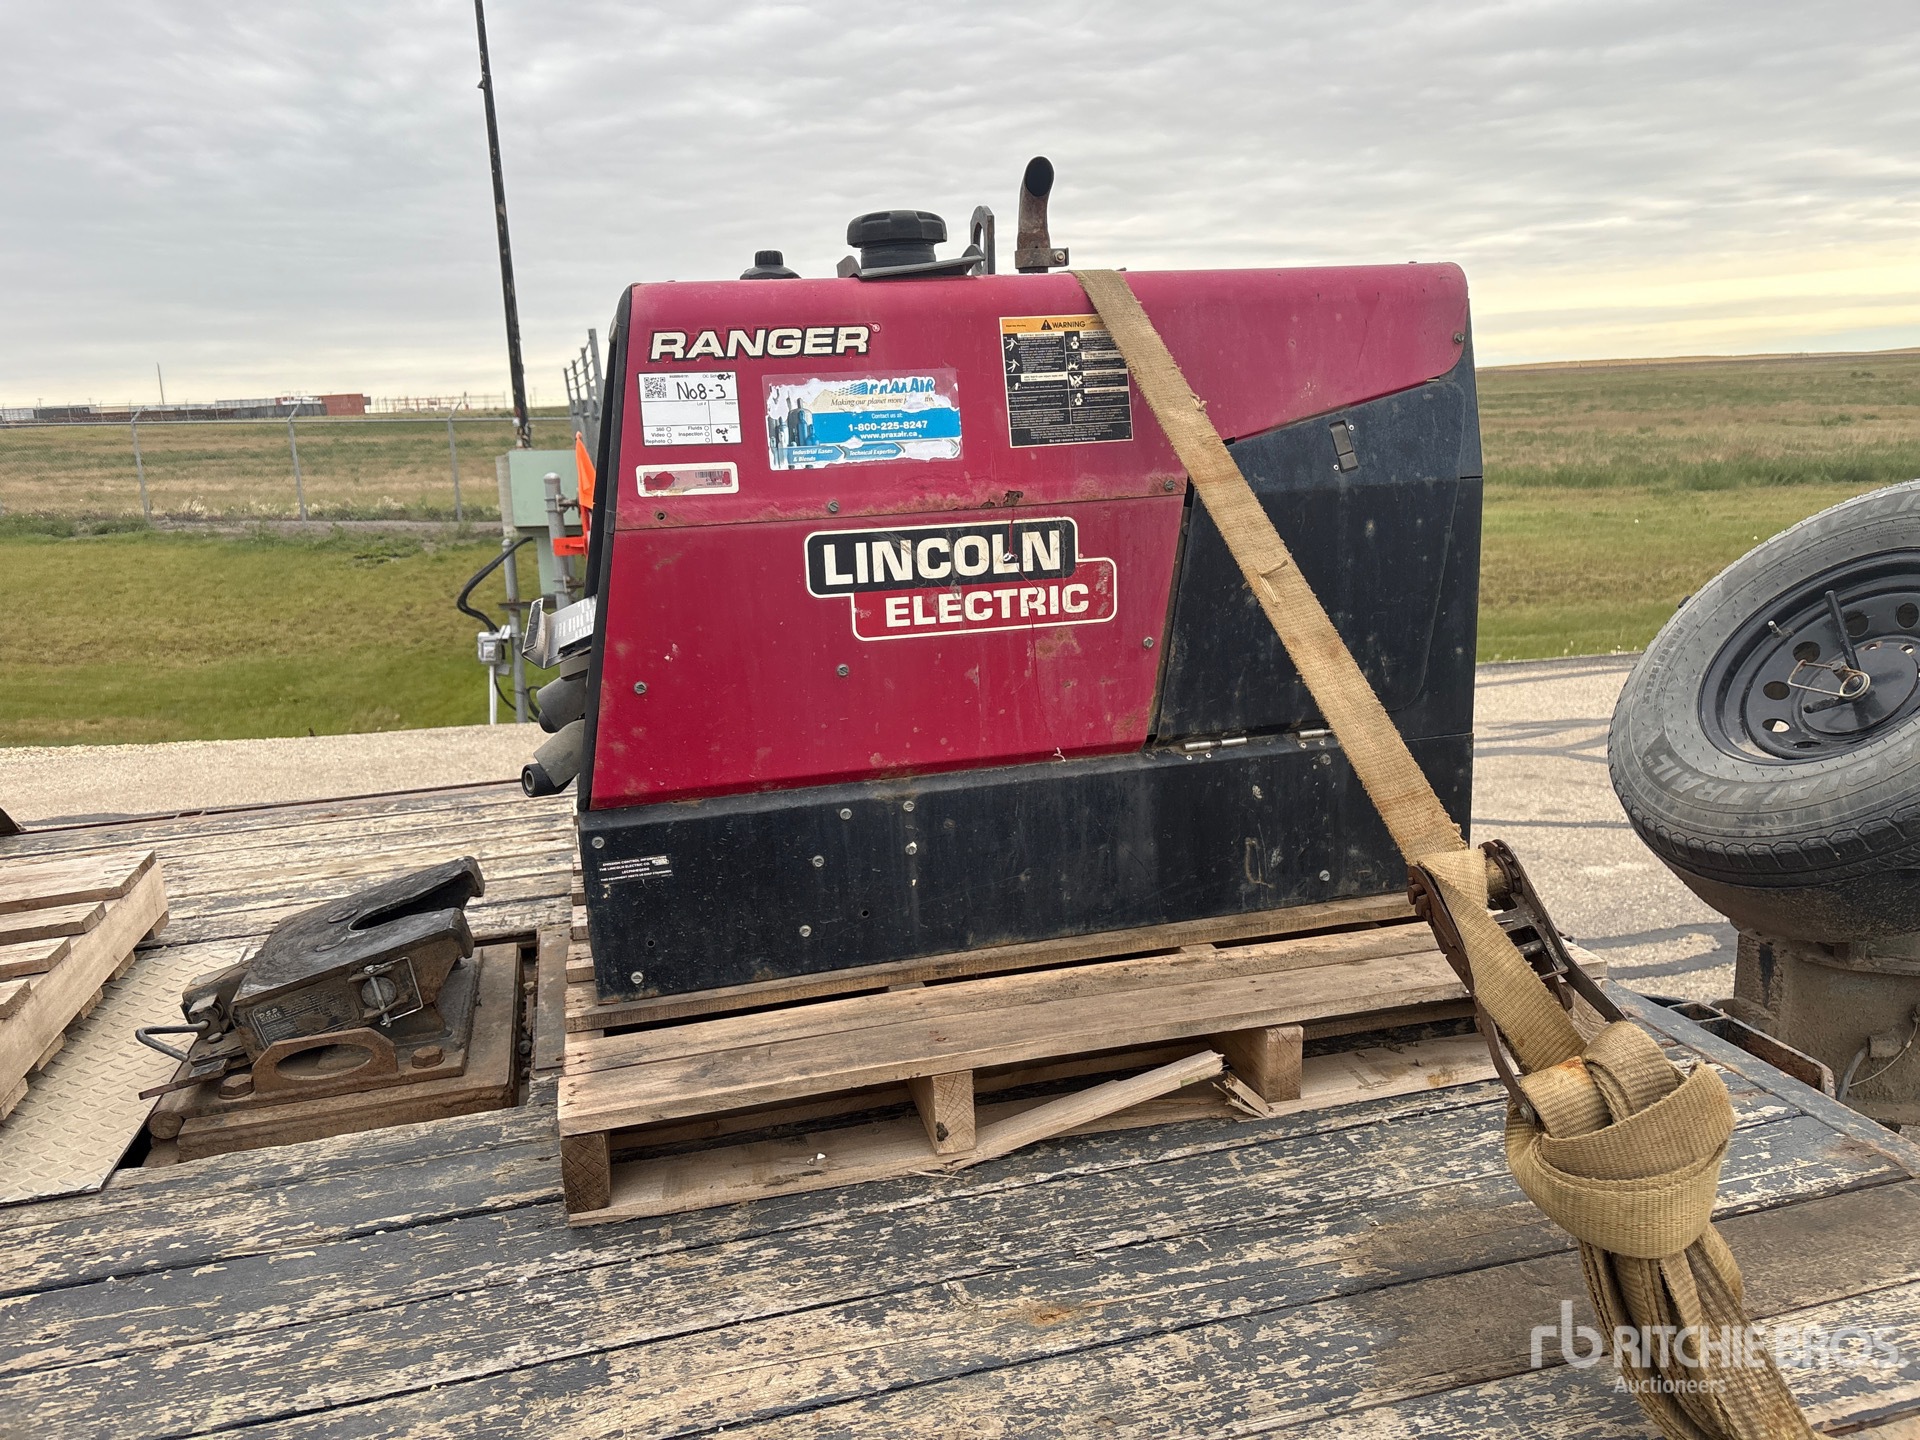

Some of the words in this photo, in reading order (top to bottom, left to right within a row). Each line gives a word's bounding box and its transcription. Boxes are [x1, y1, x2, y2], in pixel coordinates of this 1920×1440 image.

[1052, 320, 1086, 329] WARNING
[649, 326, 870, 361] RANGER
[831, 398, 855, 407] Making
[867, 398, 886, 408] planet
[848, 420, 928, 432] 1-800-225-8247
[860, 431, 918, 440] www.praxair.ca
[849, 448, 872, 456] Technical
[873, 448, 897, 456] Expertise
[823, 529, 1061, 586] LINCOLN
[885, 583, 1090, 628] ELECTRIC
[1653, 754, 1748, 806] TRAIL
